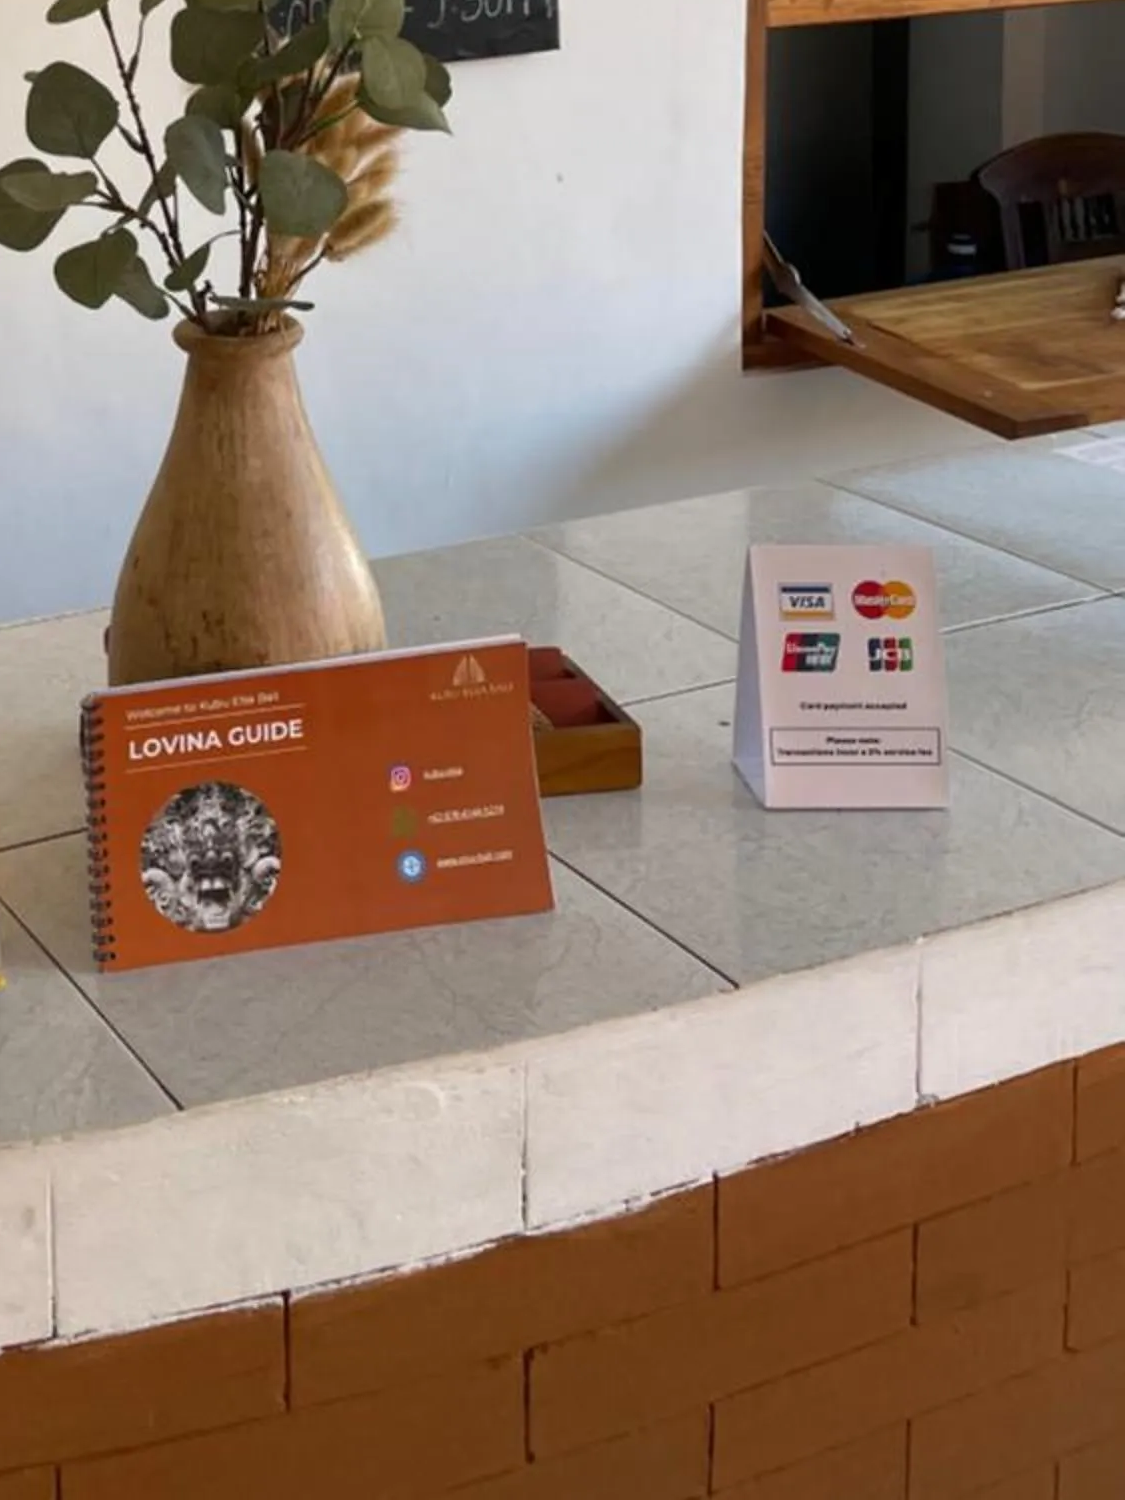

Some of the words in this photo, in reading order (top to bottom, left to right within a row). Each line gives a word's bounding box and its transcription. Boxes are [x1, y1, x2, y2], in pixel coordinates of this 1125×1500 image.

[788, 595, 826, 608] VISA
[129, 730, 222, 760] LOVINA
[228, 719, 303, 746] GUIDE
